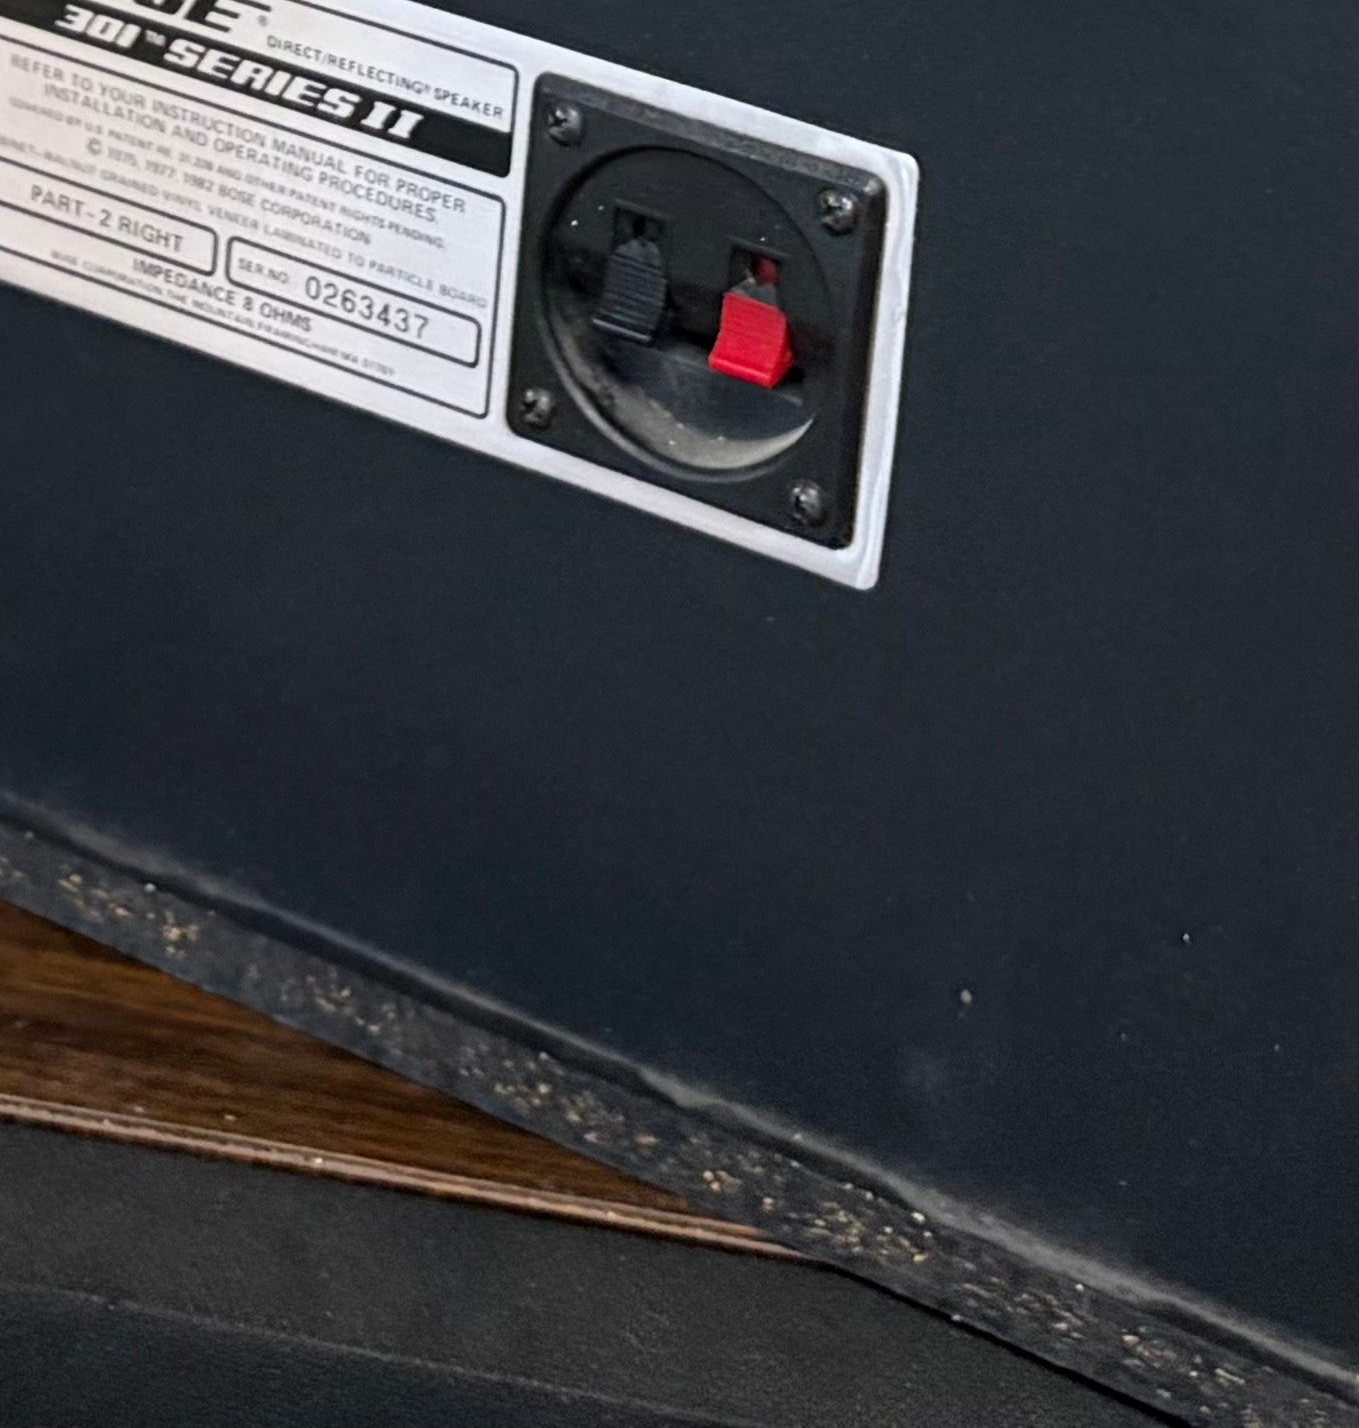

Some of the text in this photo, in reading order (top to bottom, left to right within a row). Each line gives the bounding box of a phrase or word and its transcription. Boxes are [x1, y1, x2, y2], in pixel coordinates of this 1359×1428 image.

[162, 37, 363, 120] SERIES
[359, 100, 424, 140] II
[43, 81, 166, 134] INSTALLATION
[170, 122, 209, 148] AND
[212, 136, 313, 183] OPERATING
[69, 71, 94, 93] TO
[98, 81, 147, 111] YOUR
[150, 97, 266, 149] INSTRUCTION
[271, 137, 347, 176] MANUAL
[353, 163, 390, 189] FOR
[395, 177, 466, 214] PROPER
[117, 214, 184, 254] RIGHT
[259, 197, 371, 246] CORPORATION
[132, 256, 313, 333] IMPEDANCE 8 OHMS
[303, 273, 430, 341] 0263437
